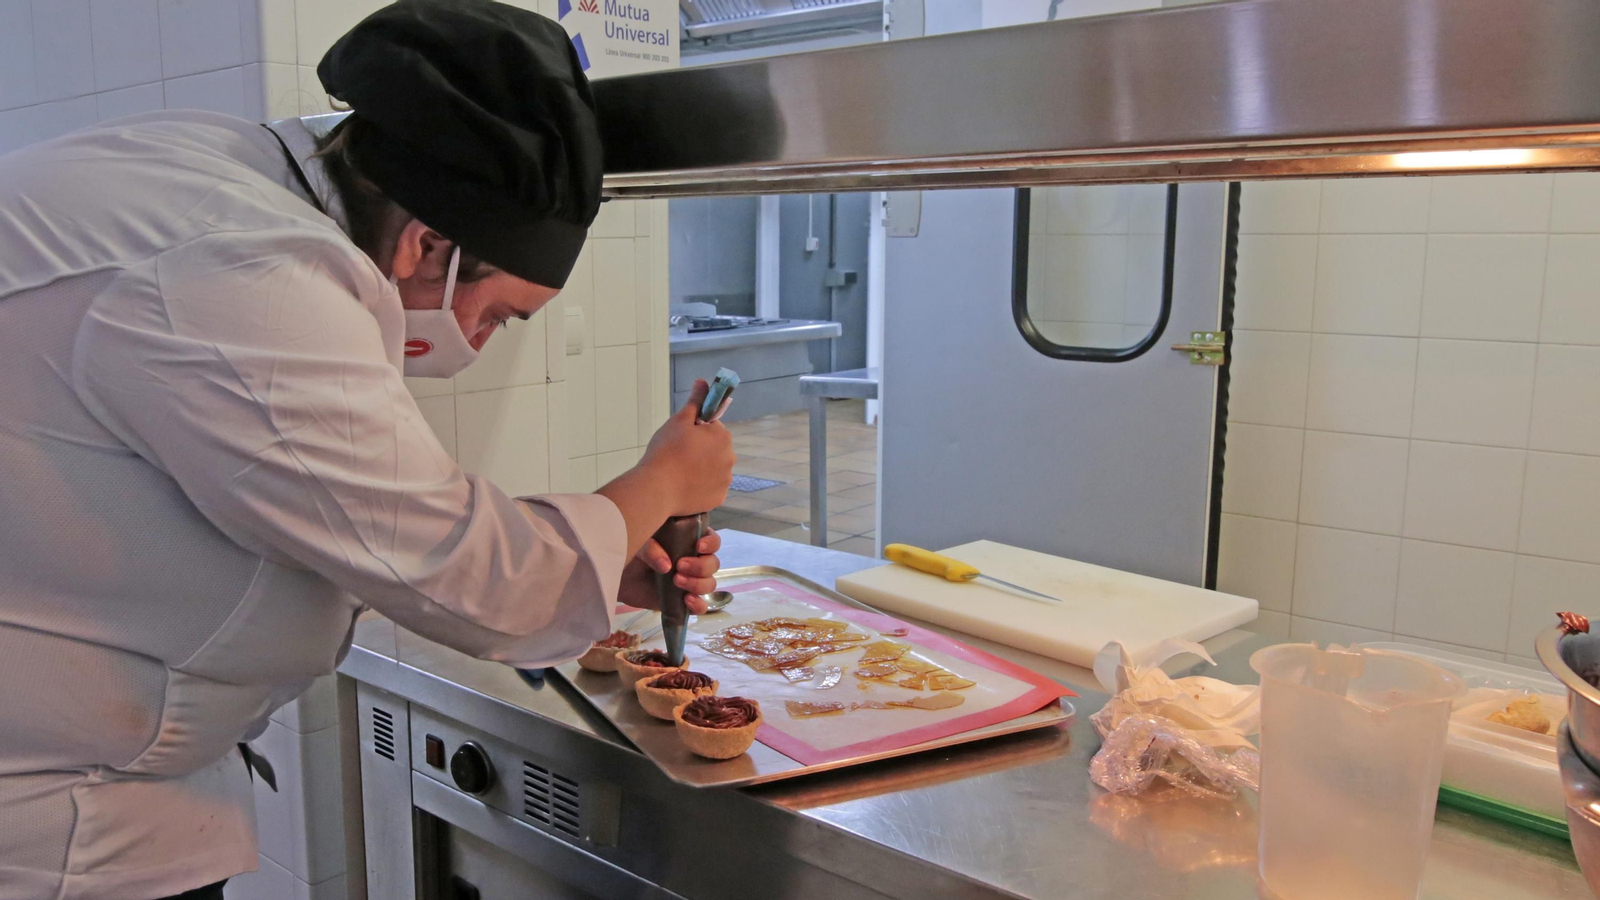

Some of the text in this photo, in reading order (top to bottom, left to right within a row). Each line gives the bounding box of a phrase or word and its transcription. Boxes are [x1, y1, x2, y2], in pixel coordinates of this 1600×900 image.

[604, 0, 649, 21] Mutua
[605, 21, 669, 46] Universal
[619, 50, 641, 59] Universal
